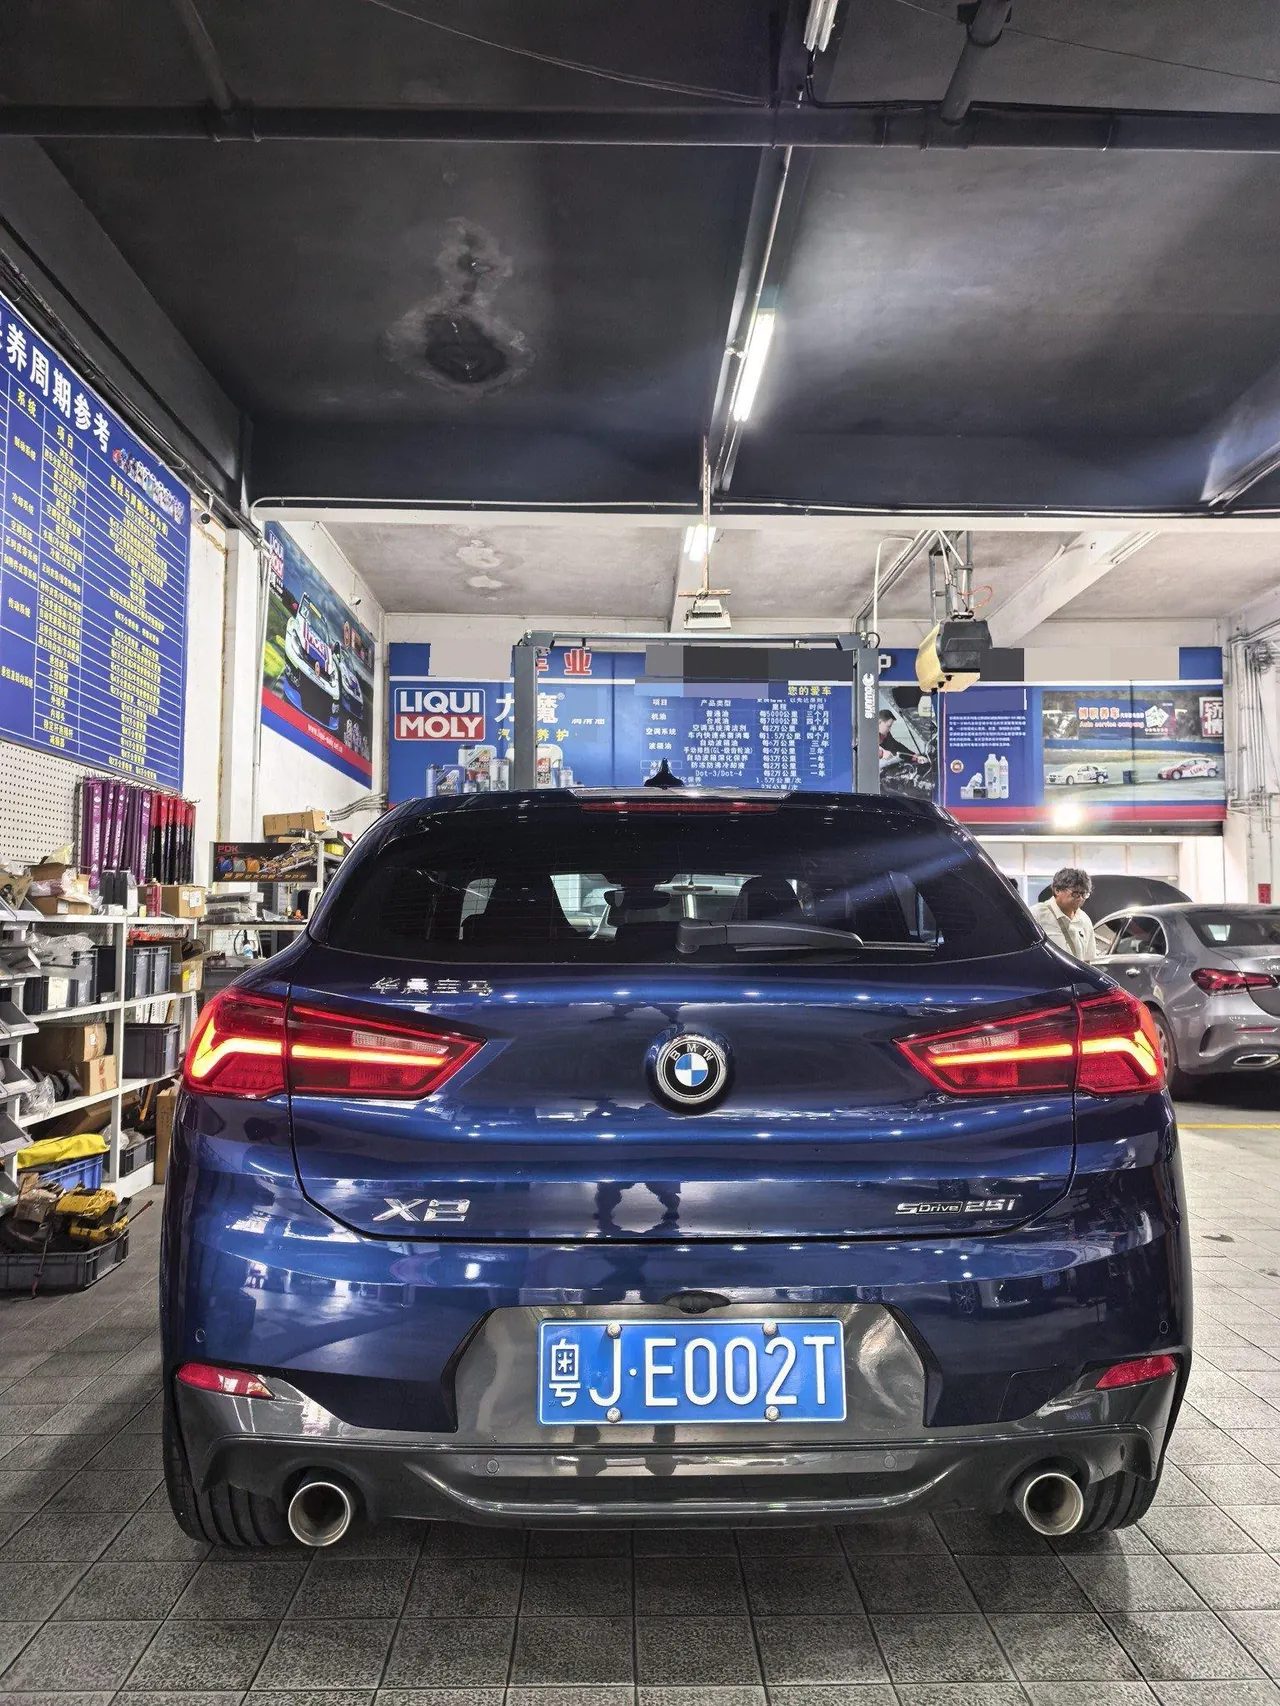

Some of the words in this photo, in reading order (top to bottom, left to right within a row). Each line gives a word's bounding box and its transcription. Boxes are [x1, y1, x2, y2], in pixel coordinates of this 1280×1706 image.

[0, 311, 110, 453] 养周期参考
[788, 686, 832, 696] 您的爱车
[400, 690, 480, 714] LIQUI
[652, 699, 668, 707] 项目
[401, 716, 483, 737] MOLY
[498, 728, 569, 742] 汽养护
[669, 1043, 714, 1061] BMW
[372, 1198, 471, 1223] X2
